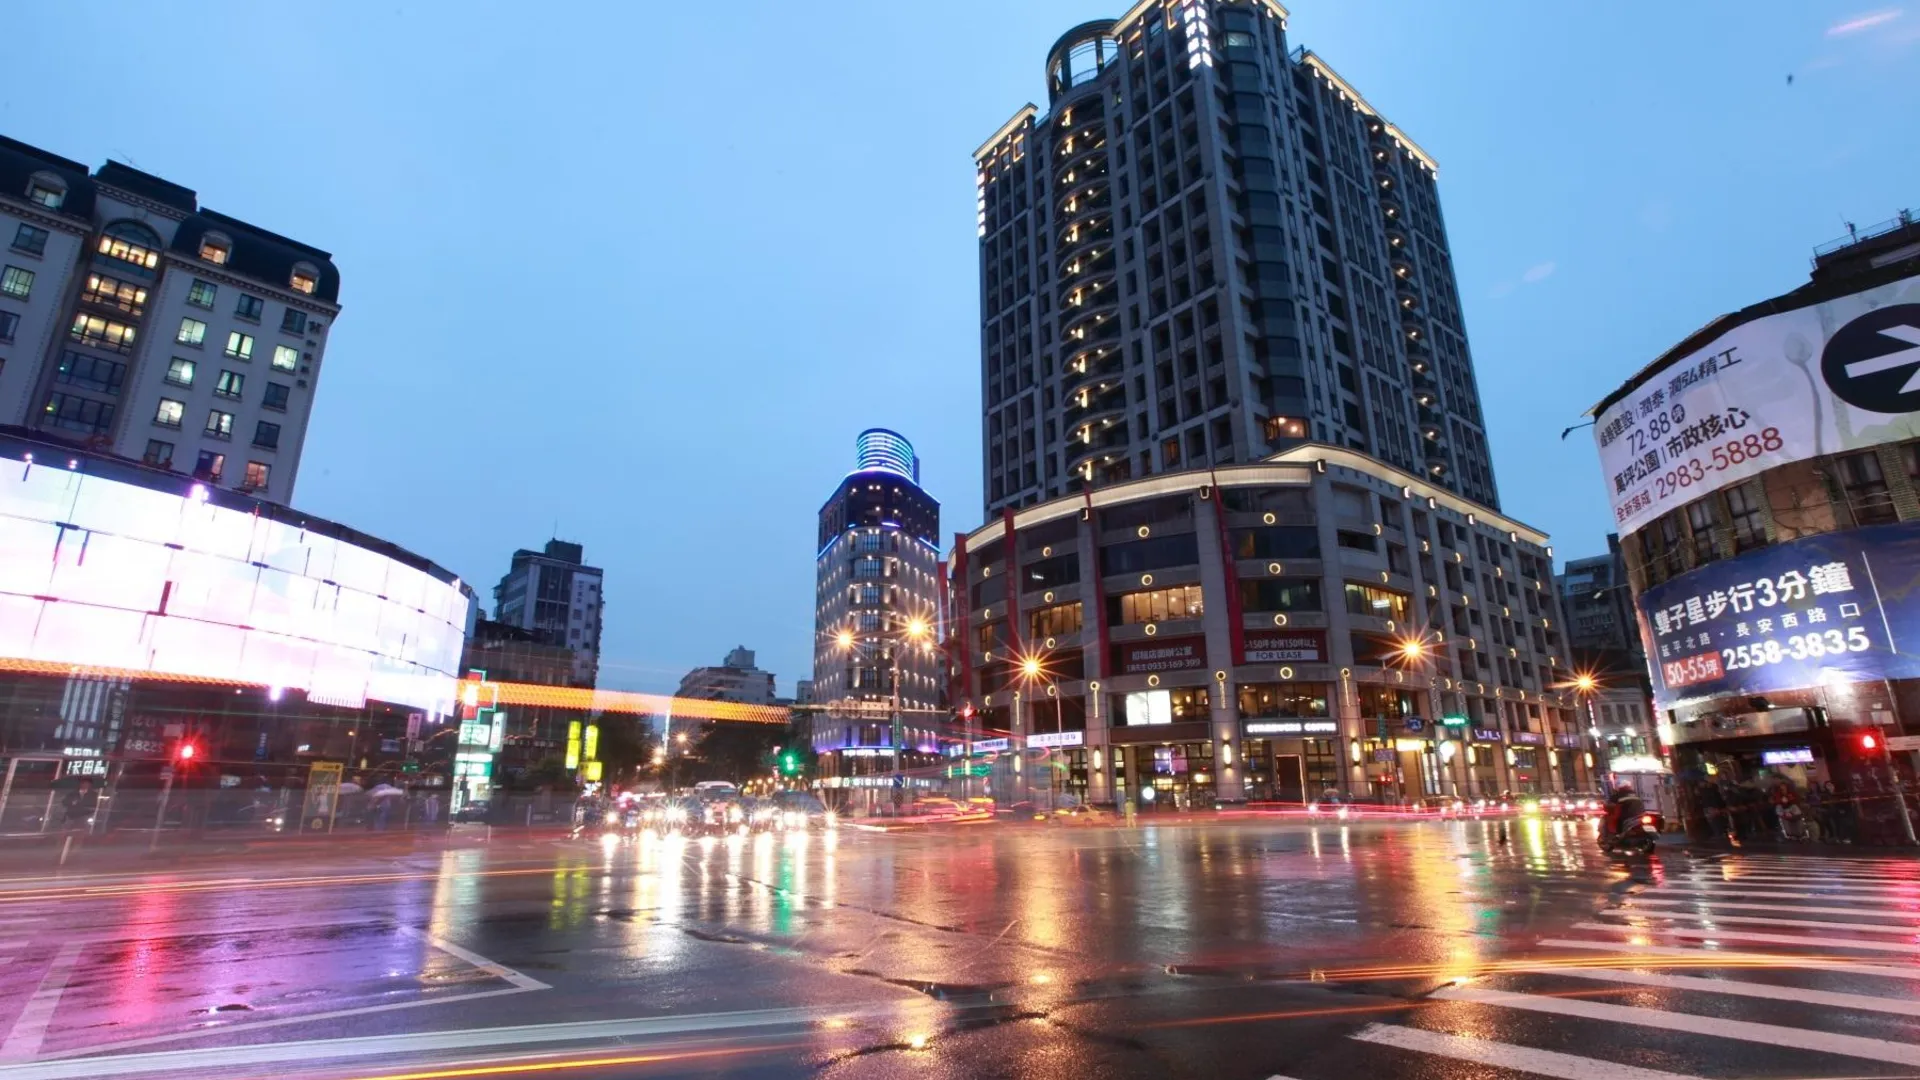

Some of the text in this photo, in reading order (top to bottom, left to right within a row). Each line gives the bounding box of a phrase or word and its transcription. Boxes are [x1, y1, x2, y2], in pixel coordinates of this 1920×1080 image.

[1656, 427, 1783, 500] 2983-5888
[1654, 562, 1854, 636] 雙子星步行3分鐘
[1256, 650, 1303, 660] FOR LEASE
[1722, 627, 1870, 671] 2558-3835
